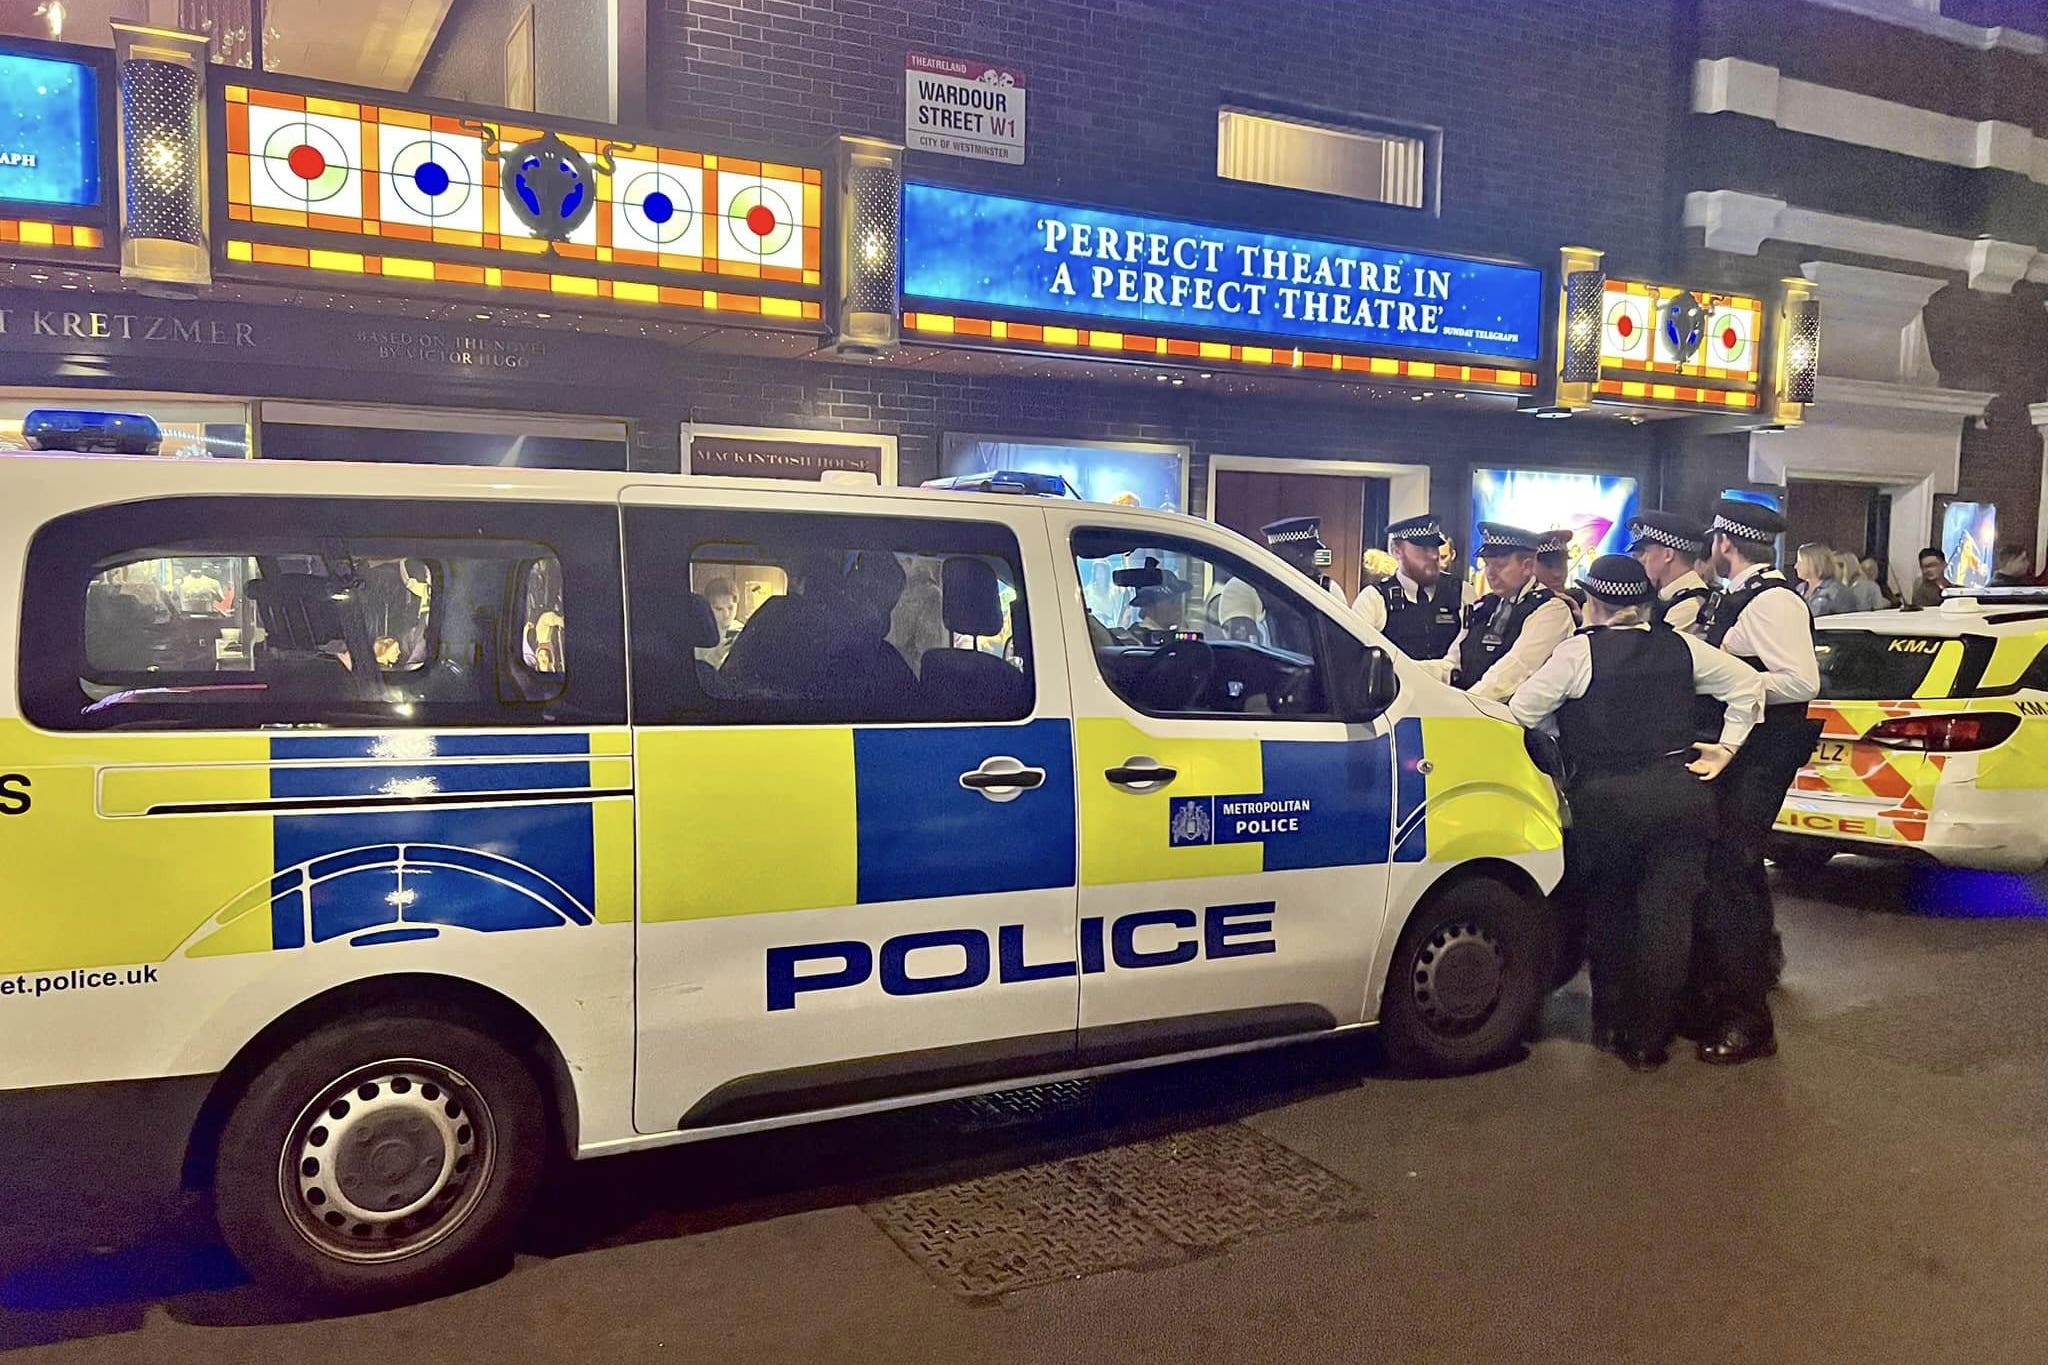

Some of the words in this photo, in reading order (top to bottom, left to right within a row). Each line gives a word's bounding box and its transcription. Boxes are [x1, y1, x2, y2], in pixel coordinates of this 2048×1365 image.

[911, 56, 967, 73] THEATRELAND
[918, 80, 1007, 113] WARDOUR
[918, 105, 984, 133] STREET
[990, 116, 1015, 138] W1
[920, 136, 938, 147] CITY
[940, 139, 950, 149] OF
[953, 141, 1009, 158] WESTMINSTER
[1236, 244, 1402, 294] THEATRE
[1413, 268, 1451, 301] IN
[1049, 262, 1076, 296] A
[1091, 266, 1266, 316] PERFECT
[34, 309, 257, 348] KRETZMER
[1442, 326, 1474, 338] SUNDAY
[1475, 330, 1519, 342] TELEGRAPH
[355, 331, 412, 345] BASED
[419, 334, 445, 348] ON
[456, 337, 487, 350] THE
[379, 346, 398, 359] BY
[404, 349, 473, 365] VICTOR
[479, 353, 529, 368] HUGO
[697, 450, 811, 467] MACKINTOSH
[818, 457, 870, 469] HOUSE
[1888, 639, 1941, 655] KMJ
[2014, 701, 2048, 716] KM
[1813, 743, 1845, 762] LZ
[1223, 800, 1311, 815] METROPOLITAN
[1236, 818, 1299, 835] POLICE
[766, 900, 1277, 1012] POLICE
[0, 964, 158, 997] et.police.uk
